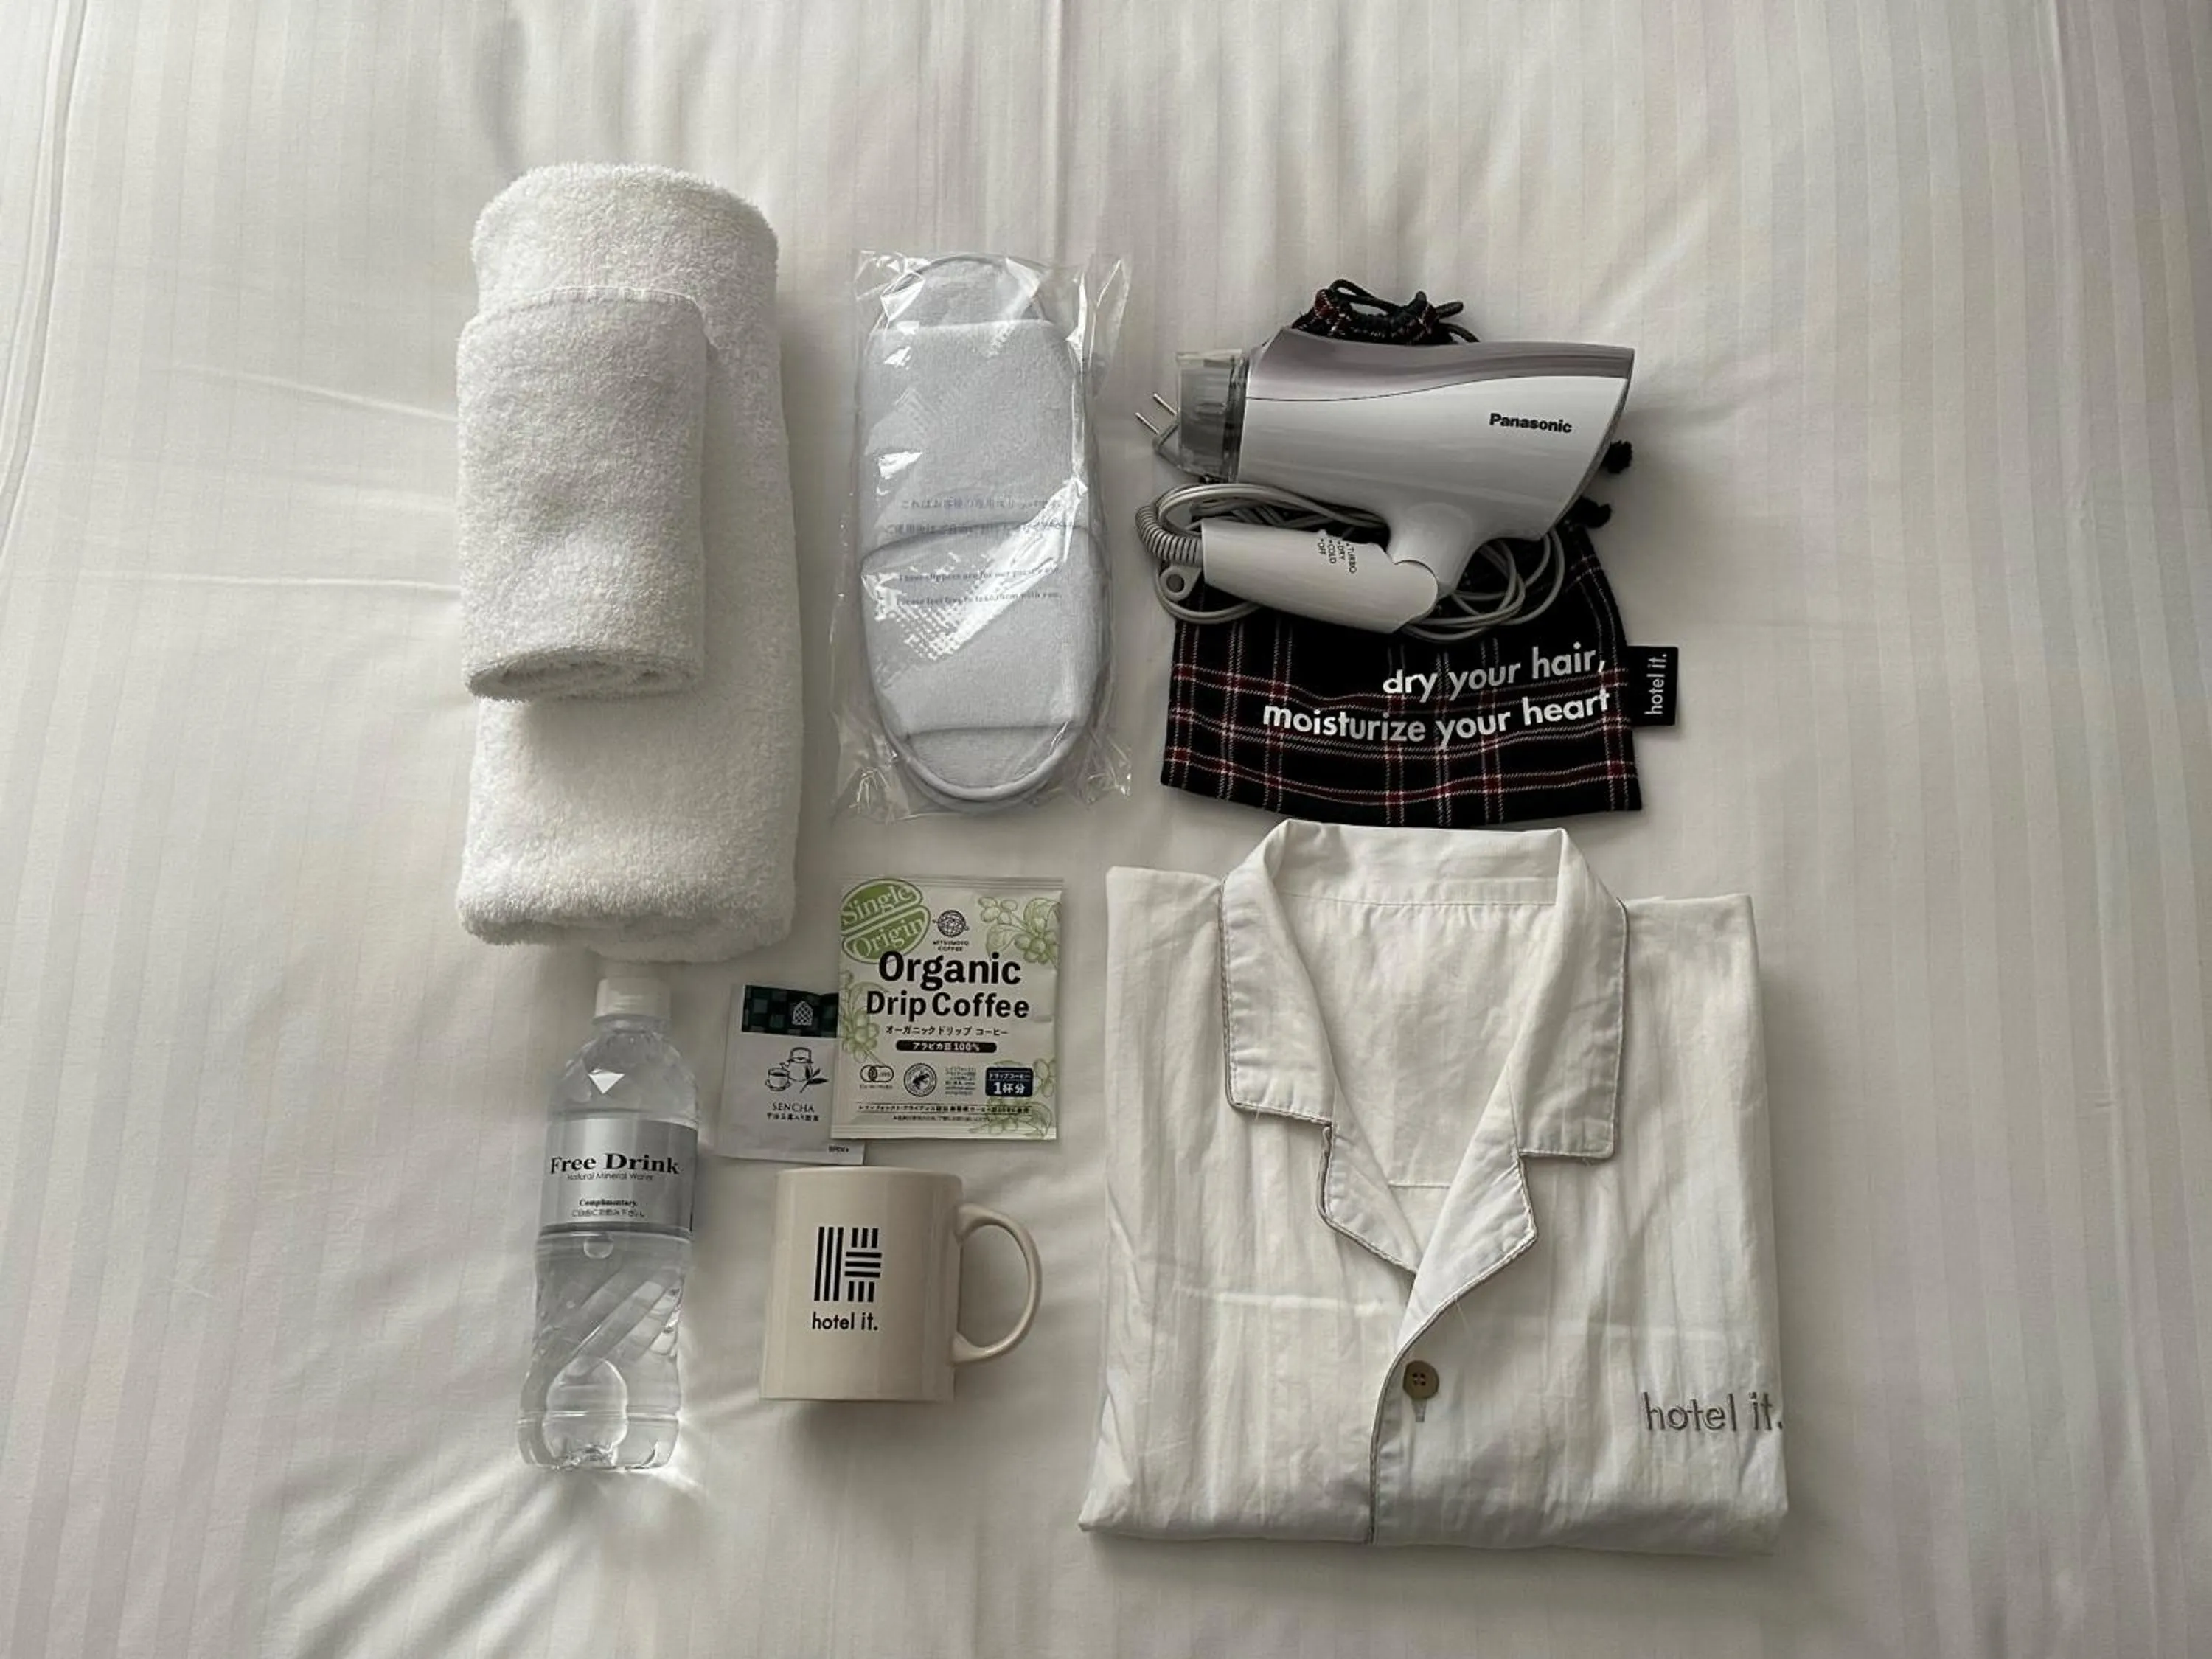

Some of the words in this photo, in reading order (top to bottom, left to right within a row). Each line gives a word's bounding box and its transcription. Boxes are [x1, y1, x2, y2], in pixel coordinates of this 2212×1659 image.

[1489, 412, 1572, 433] Panasonic
[1318, 542, 1326, 554] OFF
[1327, 544, 1336, 564] COLD
[1347, 547, 1357, 573] TURBO
[1383, 669, 1437, 703] dry
[1449, 664, 1521, 700] your
[1532, 641, 1605, 679] hair,
[1647, 653, 1667, 668] it.
[1644, 674, 1665, 714] hotel
[1263, 705, 1426, 742] moisturize
[1436, 712, 1510, 749] your
[1522, 688, 1610, 726] heart
[841, 886, 915, 926] Single
[853, 919, 923, 959] Origin
[879, 950, 1021, 991] Organic
[866, 990, 926, 1022] Drip
[932, 992, 1029, 1018] Coffee
[886, 1025, 936, 1035] オーガニック
[939, 1026, 972, 1036] ドリップ
[976, 1028, 1009, 1036] コーヒー
[993, 1082, 1025, 1094] 1杯分
[772, 1102, 815, 1113] SENCHA
[551, 1156, 597, 1174] Free
[603, 1152, 679, 1174] Drink
[812, 1312, 855, 1329] hotel
[860, 1312, 878, 1331] it.
[1643, 1391, 1736, 1432] hotel
[1749, 1391, 1783, 1432] it.
